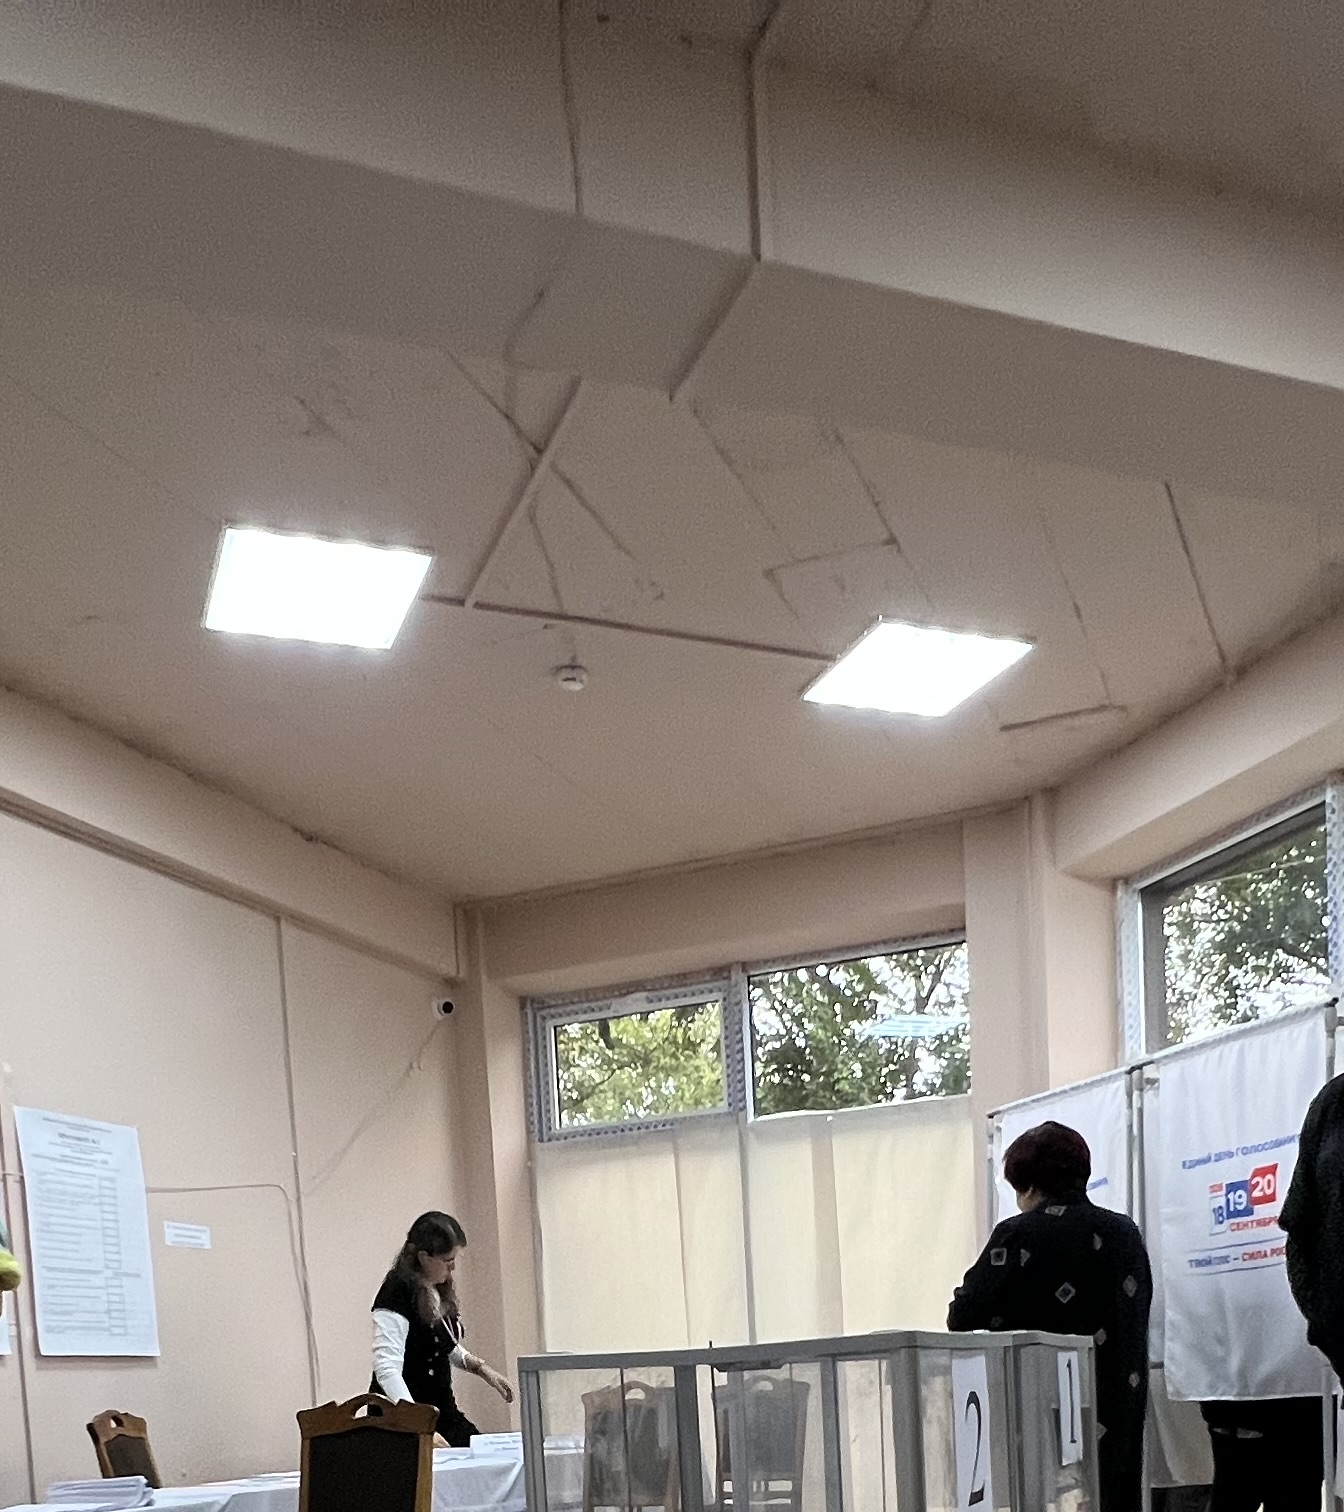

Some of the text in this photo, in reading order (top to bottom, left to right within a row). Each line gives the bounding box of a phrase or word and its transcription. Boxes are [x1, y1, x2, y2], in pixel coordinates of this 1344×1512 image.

[1250, 1173, 1275, 1198] 20
[1227, 1189, 1248, 1212] 19
[1212, 1205, 1225, 1226] 18
[1066, 1358, 1078, 1445] 1
[964, 1390, 986, 1508] 2
